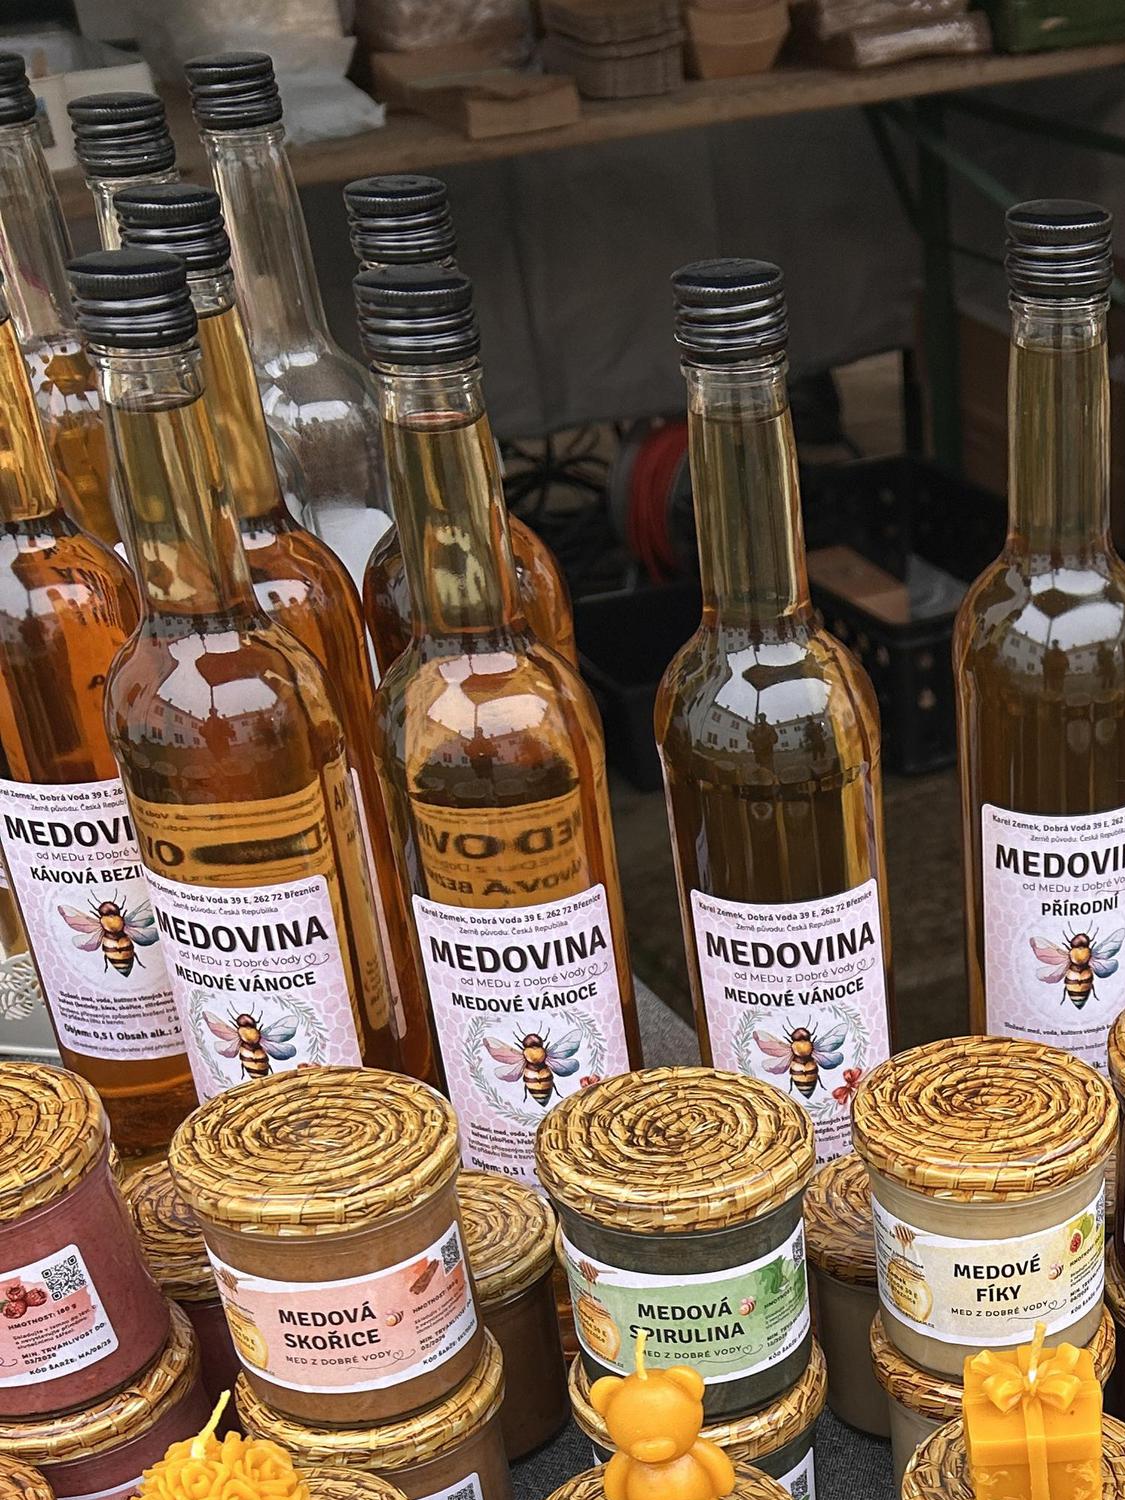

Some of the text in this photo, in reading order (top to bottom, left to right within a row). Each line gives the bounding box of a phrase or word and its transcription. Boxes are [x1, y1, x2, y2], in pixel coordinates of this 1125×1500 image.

[12, 790, 37, 800] Zemek,
[40, 792, 65, 801] Dobrá
[992, 815, 1011, 826] Karel
[1012, 820, 1041, 832] Zemek,
[1070, 824, 1091, 832] Voda
[1111, 817, 1123, 826] 262
[52, 850, 129, 861] MEDu Dobré
[30, 866, 98, 884] KÁVOVÁ
[181, 883, 320, 904] Dobrá Voda 39 262 72 Březnice
[1023, 882, 1035, 890] od
[1039, 884, 1071, 893] MEDu
[1082, 879, 1112, 891] Dobré
[421, 905, 438, 917] Karel
[440, 912, 468, 924] Zemek,
[500, 917, 522, 925] Voda
[524, 914, 534, 922] 39
[546, 909, 561, 918] 262
[563, 906, 572, 914] 72
[574, 893, 601, 911] Březnice
[699, 902, 715, 914] Karel
[718, 907, 745, 920] Zemek,
[748, 913, 774, 921] Dobrá
[775, 913, 797, 921] Voda
[800, 912, 810, 920] 39
[821, 906, 835, 916] 262
[1042, 891, 1119, 916] PŘÍRODNÍ
[155, 907, 329, 953] MEDOVINA
[430, 925, 607, 973] MEDOVINA
[705, 921, 875, 969] MEDOVINA
[179, 950, 301, 967] od MEDu z Dobré Vody
[175, 963, 316, 992] MEDOVÉ VÁNOCE
[461, 977, 473, 985] od
[477, 978, 511, 988] MEDu
[524, 976, 558, 987] Dobré
[560, 966, 586, 982] Vody
[734, 972, 747, 980] od
[751, 974, 783, 983] MEDu
[796, 970, 828, 982] Dobré
[831, 962, 855, 976] Vody
[452, 982, 598, 1013] MEDOVÉ VÁNOCE
[725, 977, 864, 1007] MEDOVÉ VÁNOCE
[116, 1031, 148, 1040] Obsah
[953, 1254, 1041, 1280] MEDOVÉ
[976, 1285, 1022, 1302] FÍKY
[278, 1301, 376, 1327] MEDOVÁ
[638, 1296, 732, 1321] MEDOVÁ
[951, 1307, 972, 1316] MED
[985, 1307, 1020, 1317] DOBRÉ
[1023, 1300, 1048, 1313] VODY
[284, 1329, 381, 1350] SKOŘICE
[629, 1321, 745, 1344] SPIRULINA
[22, 1330, 93, 1359] MIN. TRVANLIVOST
[675, 1349, 711, 1359] DOBRÉ
[714, 1345, 741, 1357] VODY
[286, 1356, 308, 1365] MED
[321, 1356, 359, 1366] DOBRÉ
[362, 1350, 392, 1362] VODY
